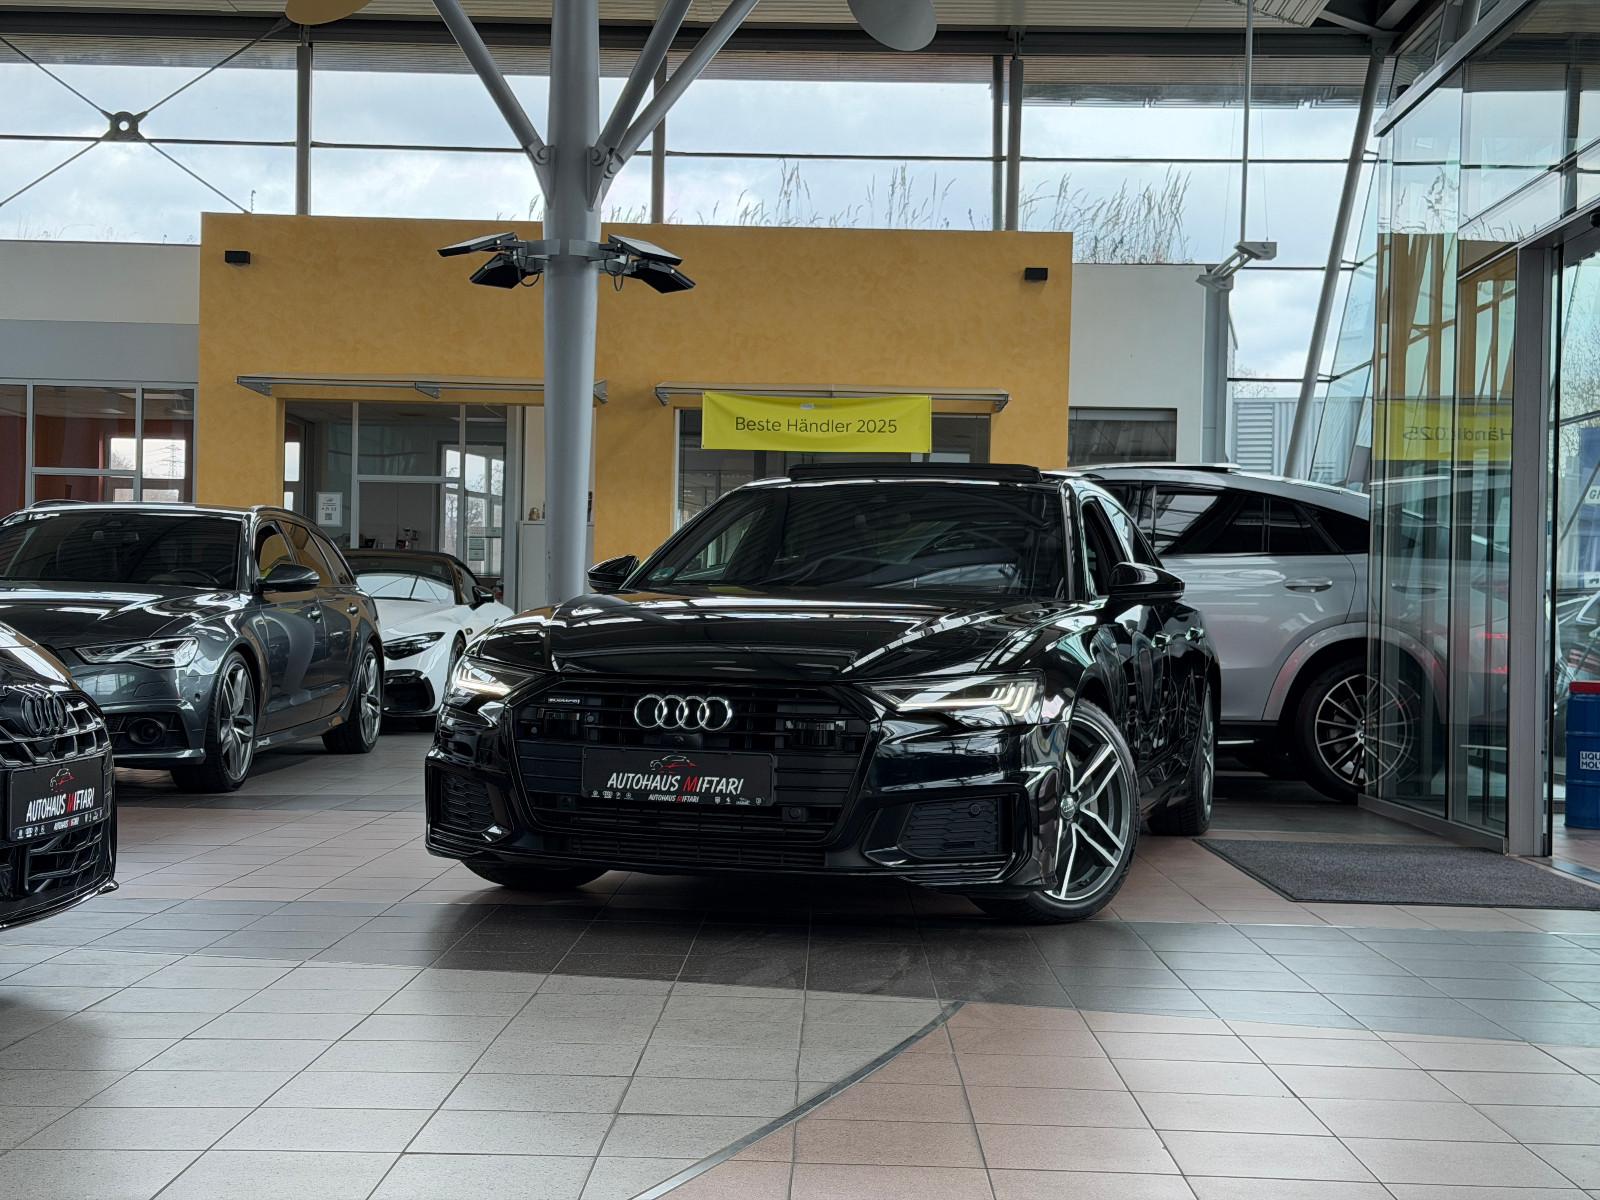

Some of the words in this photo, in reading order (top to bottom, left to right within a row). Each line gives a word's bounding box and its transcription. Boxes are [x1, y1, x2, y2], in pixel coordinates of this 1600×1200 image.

[735, 417, 781, 432] Beste
[788, 418, 852, 433] Händler
[856, 419, 897, 434] 2025
[607, 773, 680, 792] AUTOHAUS
[682, 776, 744, 795] MIFTARI
[26, 793, 66, 822] AUTOHAUS
